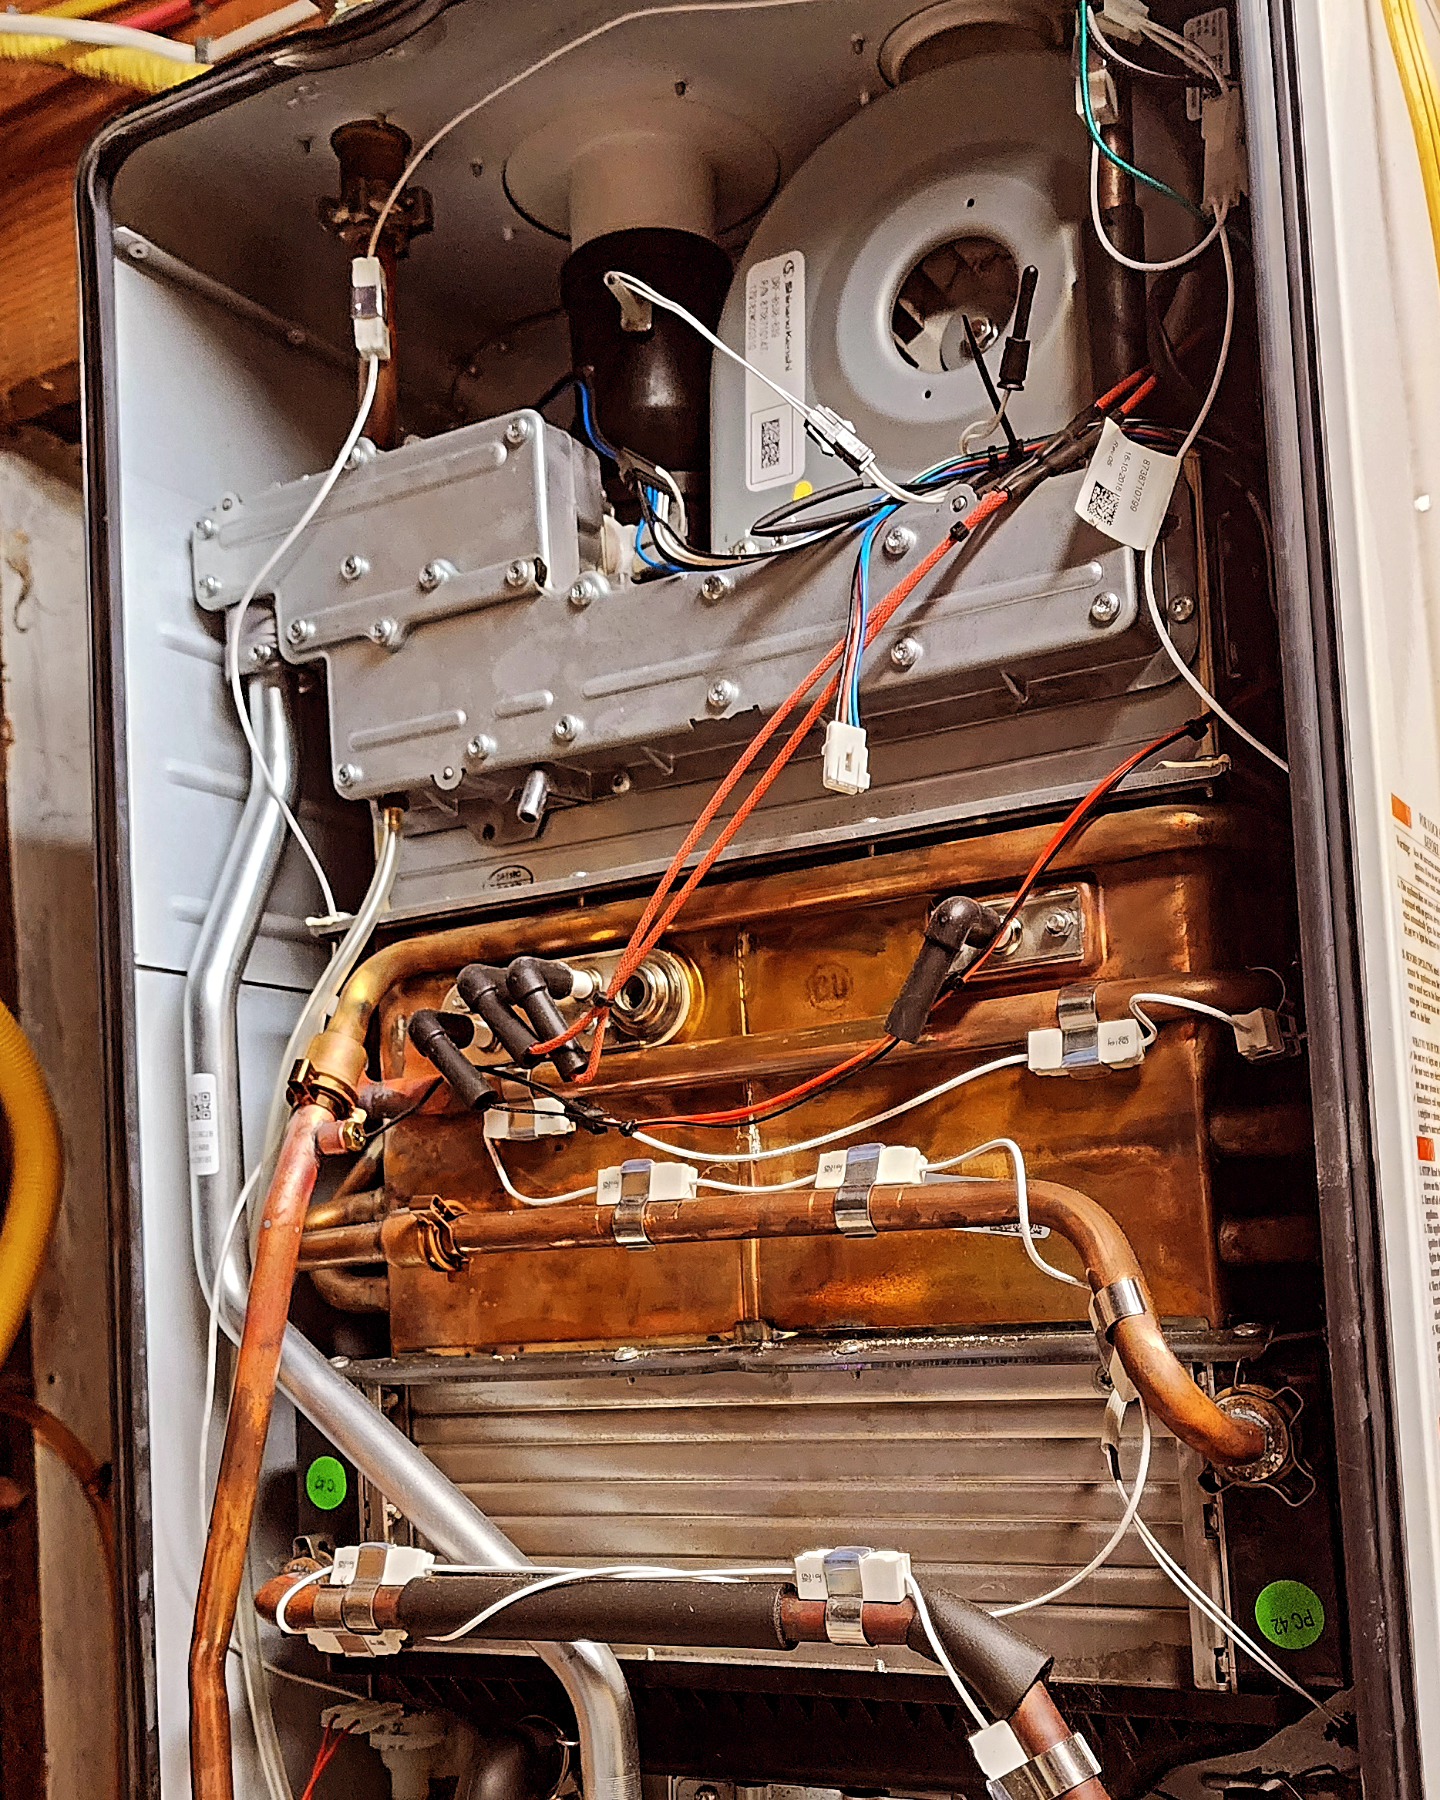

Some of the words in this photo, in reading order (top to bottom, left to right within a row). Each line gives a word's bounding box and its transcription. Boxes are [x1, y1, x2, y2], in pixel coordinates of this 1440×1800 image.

[1130, 459, 1151, 512] 8738710799
[1271, 1617, 1288, 1635] 42
[1291, 1609, 1315, 1630] PC
